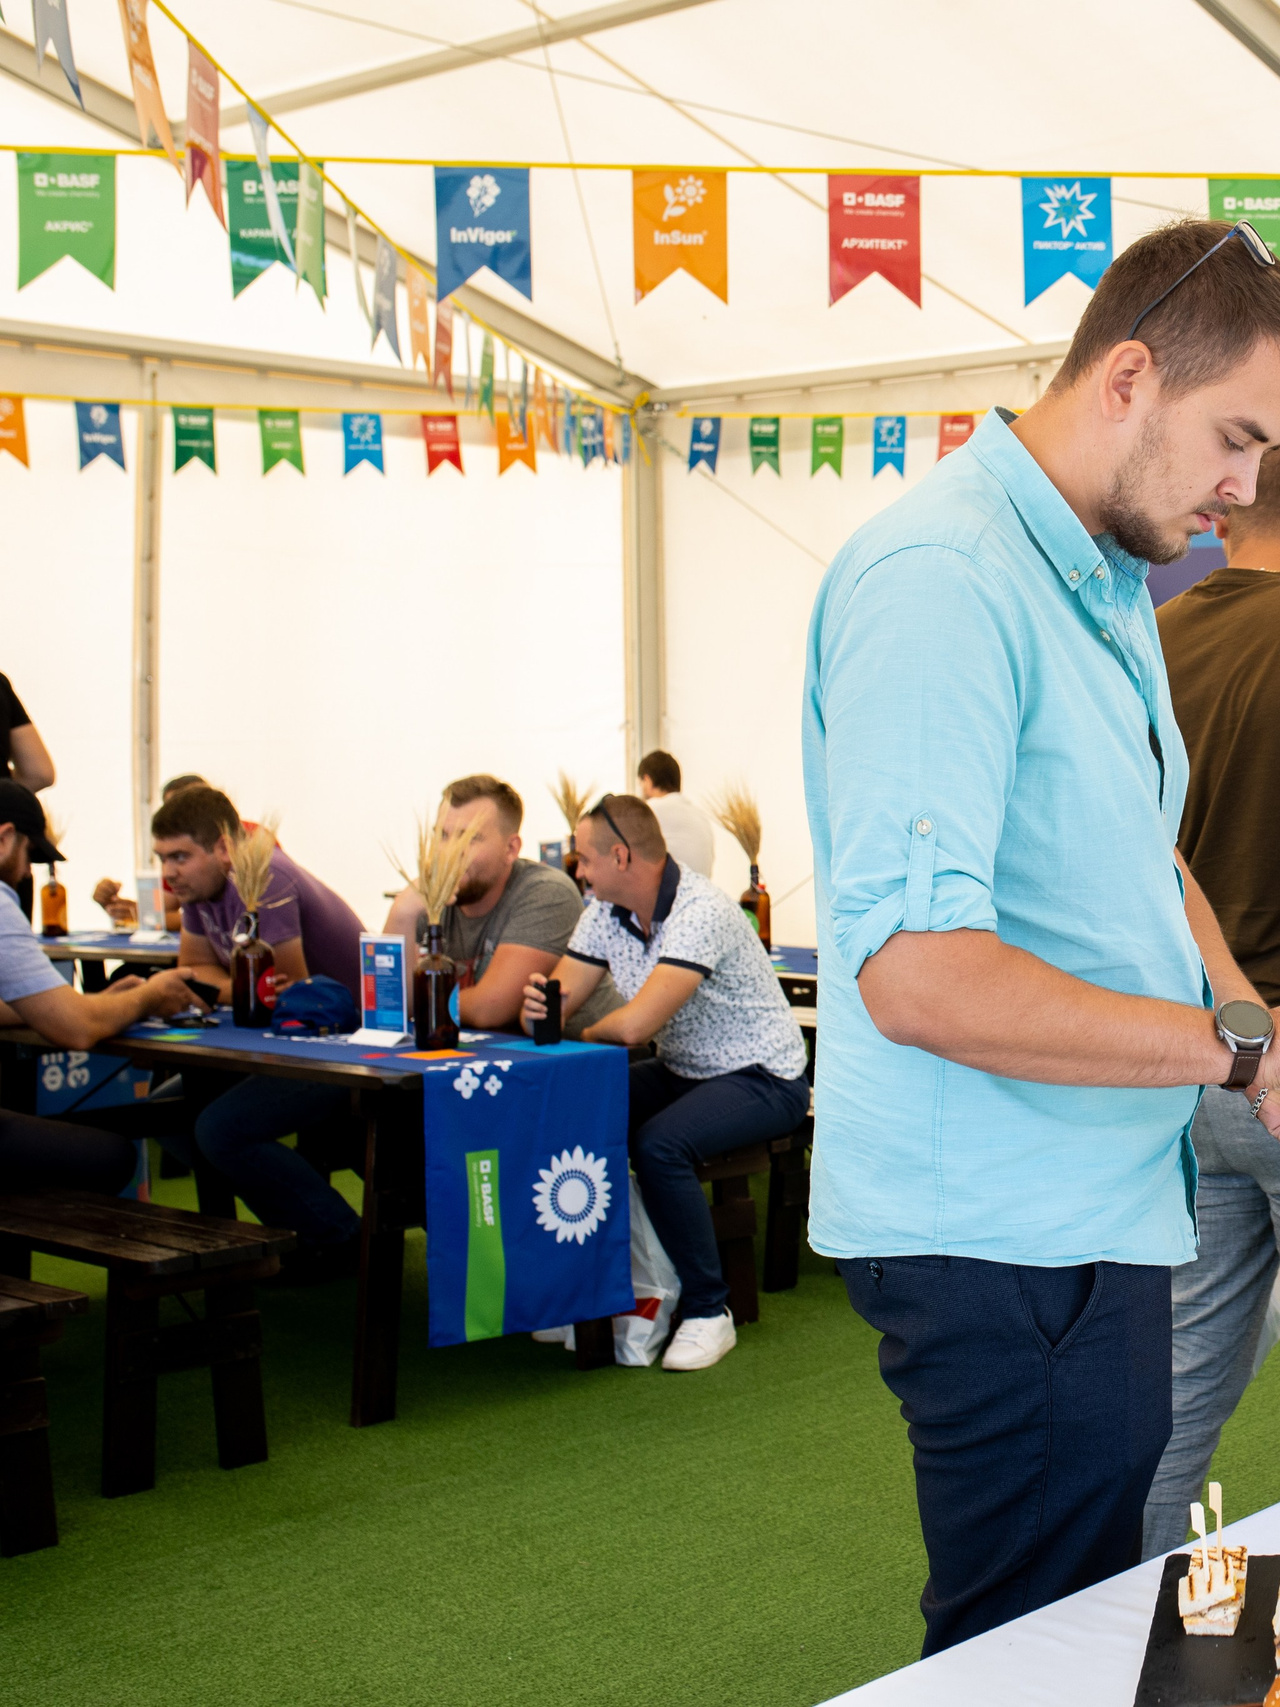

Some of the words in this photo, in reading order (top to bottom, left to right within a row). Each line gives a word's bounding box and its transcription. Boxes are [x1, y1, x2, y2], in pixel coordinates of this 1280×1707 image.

[57, 173, 100, 188] BASF
[864, 193, 905, 207] BASF
[450, 226, 513, 246] InVigor
[653, 229, 704, 245] InSun
[481, 1183, 495, 1227] BASF
